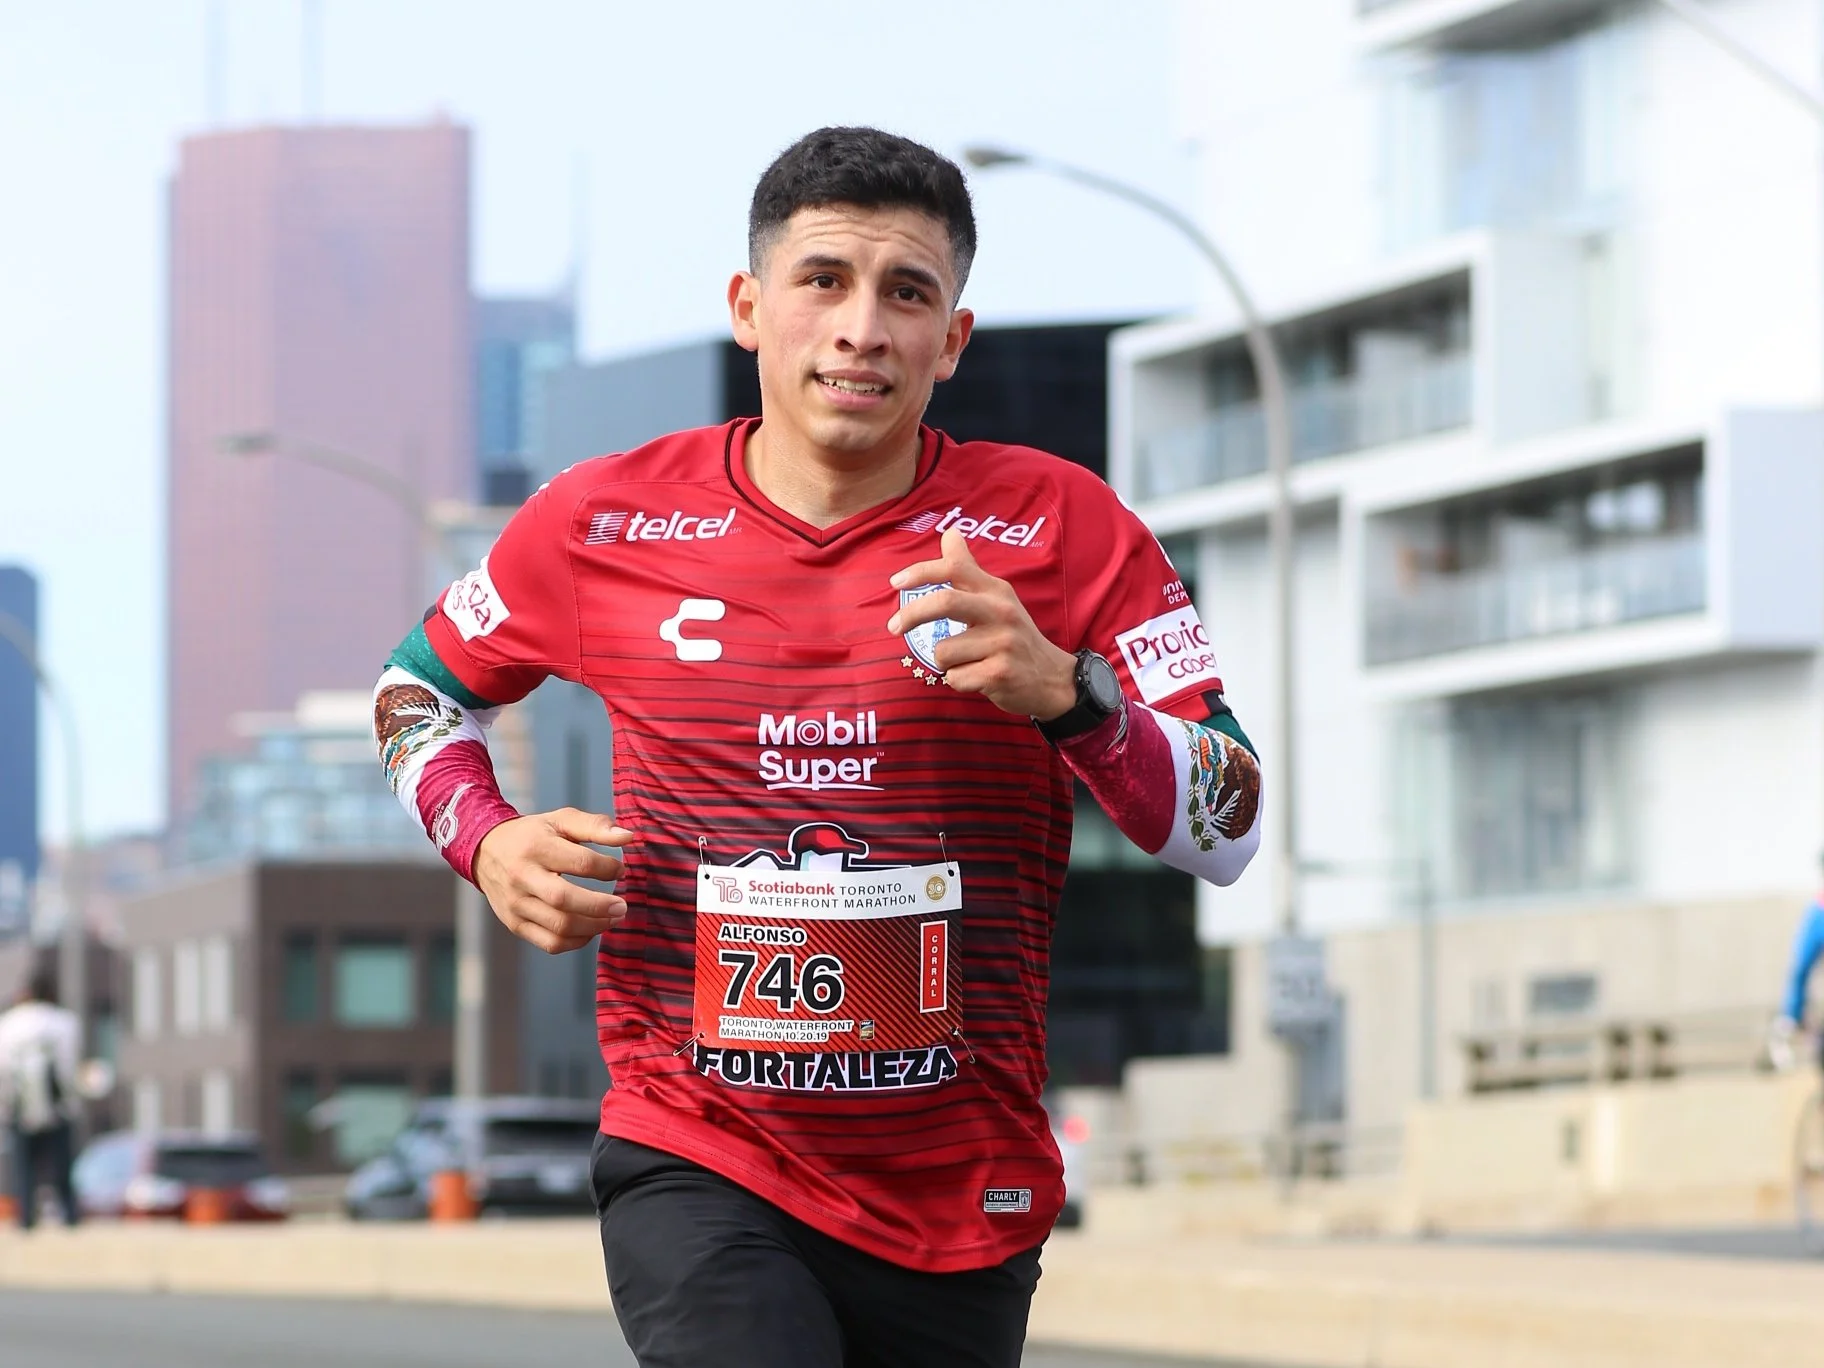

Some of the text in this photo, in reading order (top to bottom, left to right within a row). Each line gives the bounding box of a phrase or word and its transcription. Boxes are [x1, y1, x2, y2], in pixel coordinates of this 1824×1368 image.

[625, 507, 736, 542] telcel
[935, 506, 1046, 547] telcel
[758, 710, 877, 746] Mobil
[758, 750, 878, 791] Super
[748, 880, 835, 896] Scotiabank
[840, 882, 902, 896] TORONTO
[749, 894, 916, 909] WATERFRONT MARATHON
[721, 925, 805, 944] ALFONSO
[720, 951, 843, 1012] 746
[930, 934, 939, 998] CORRAL
[721, 1028, 828, 1041] MARATHON 10.20.19
[776, 1020, 852, 1031] WATERFRONT
[696, 1046, 957, 1091] FORTALEZA
[988, 1192, 1018, 1201] CHARLY
